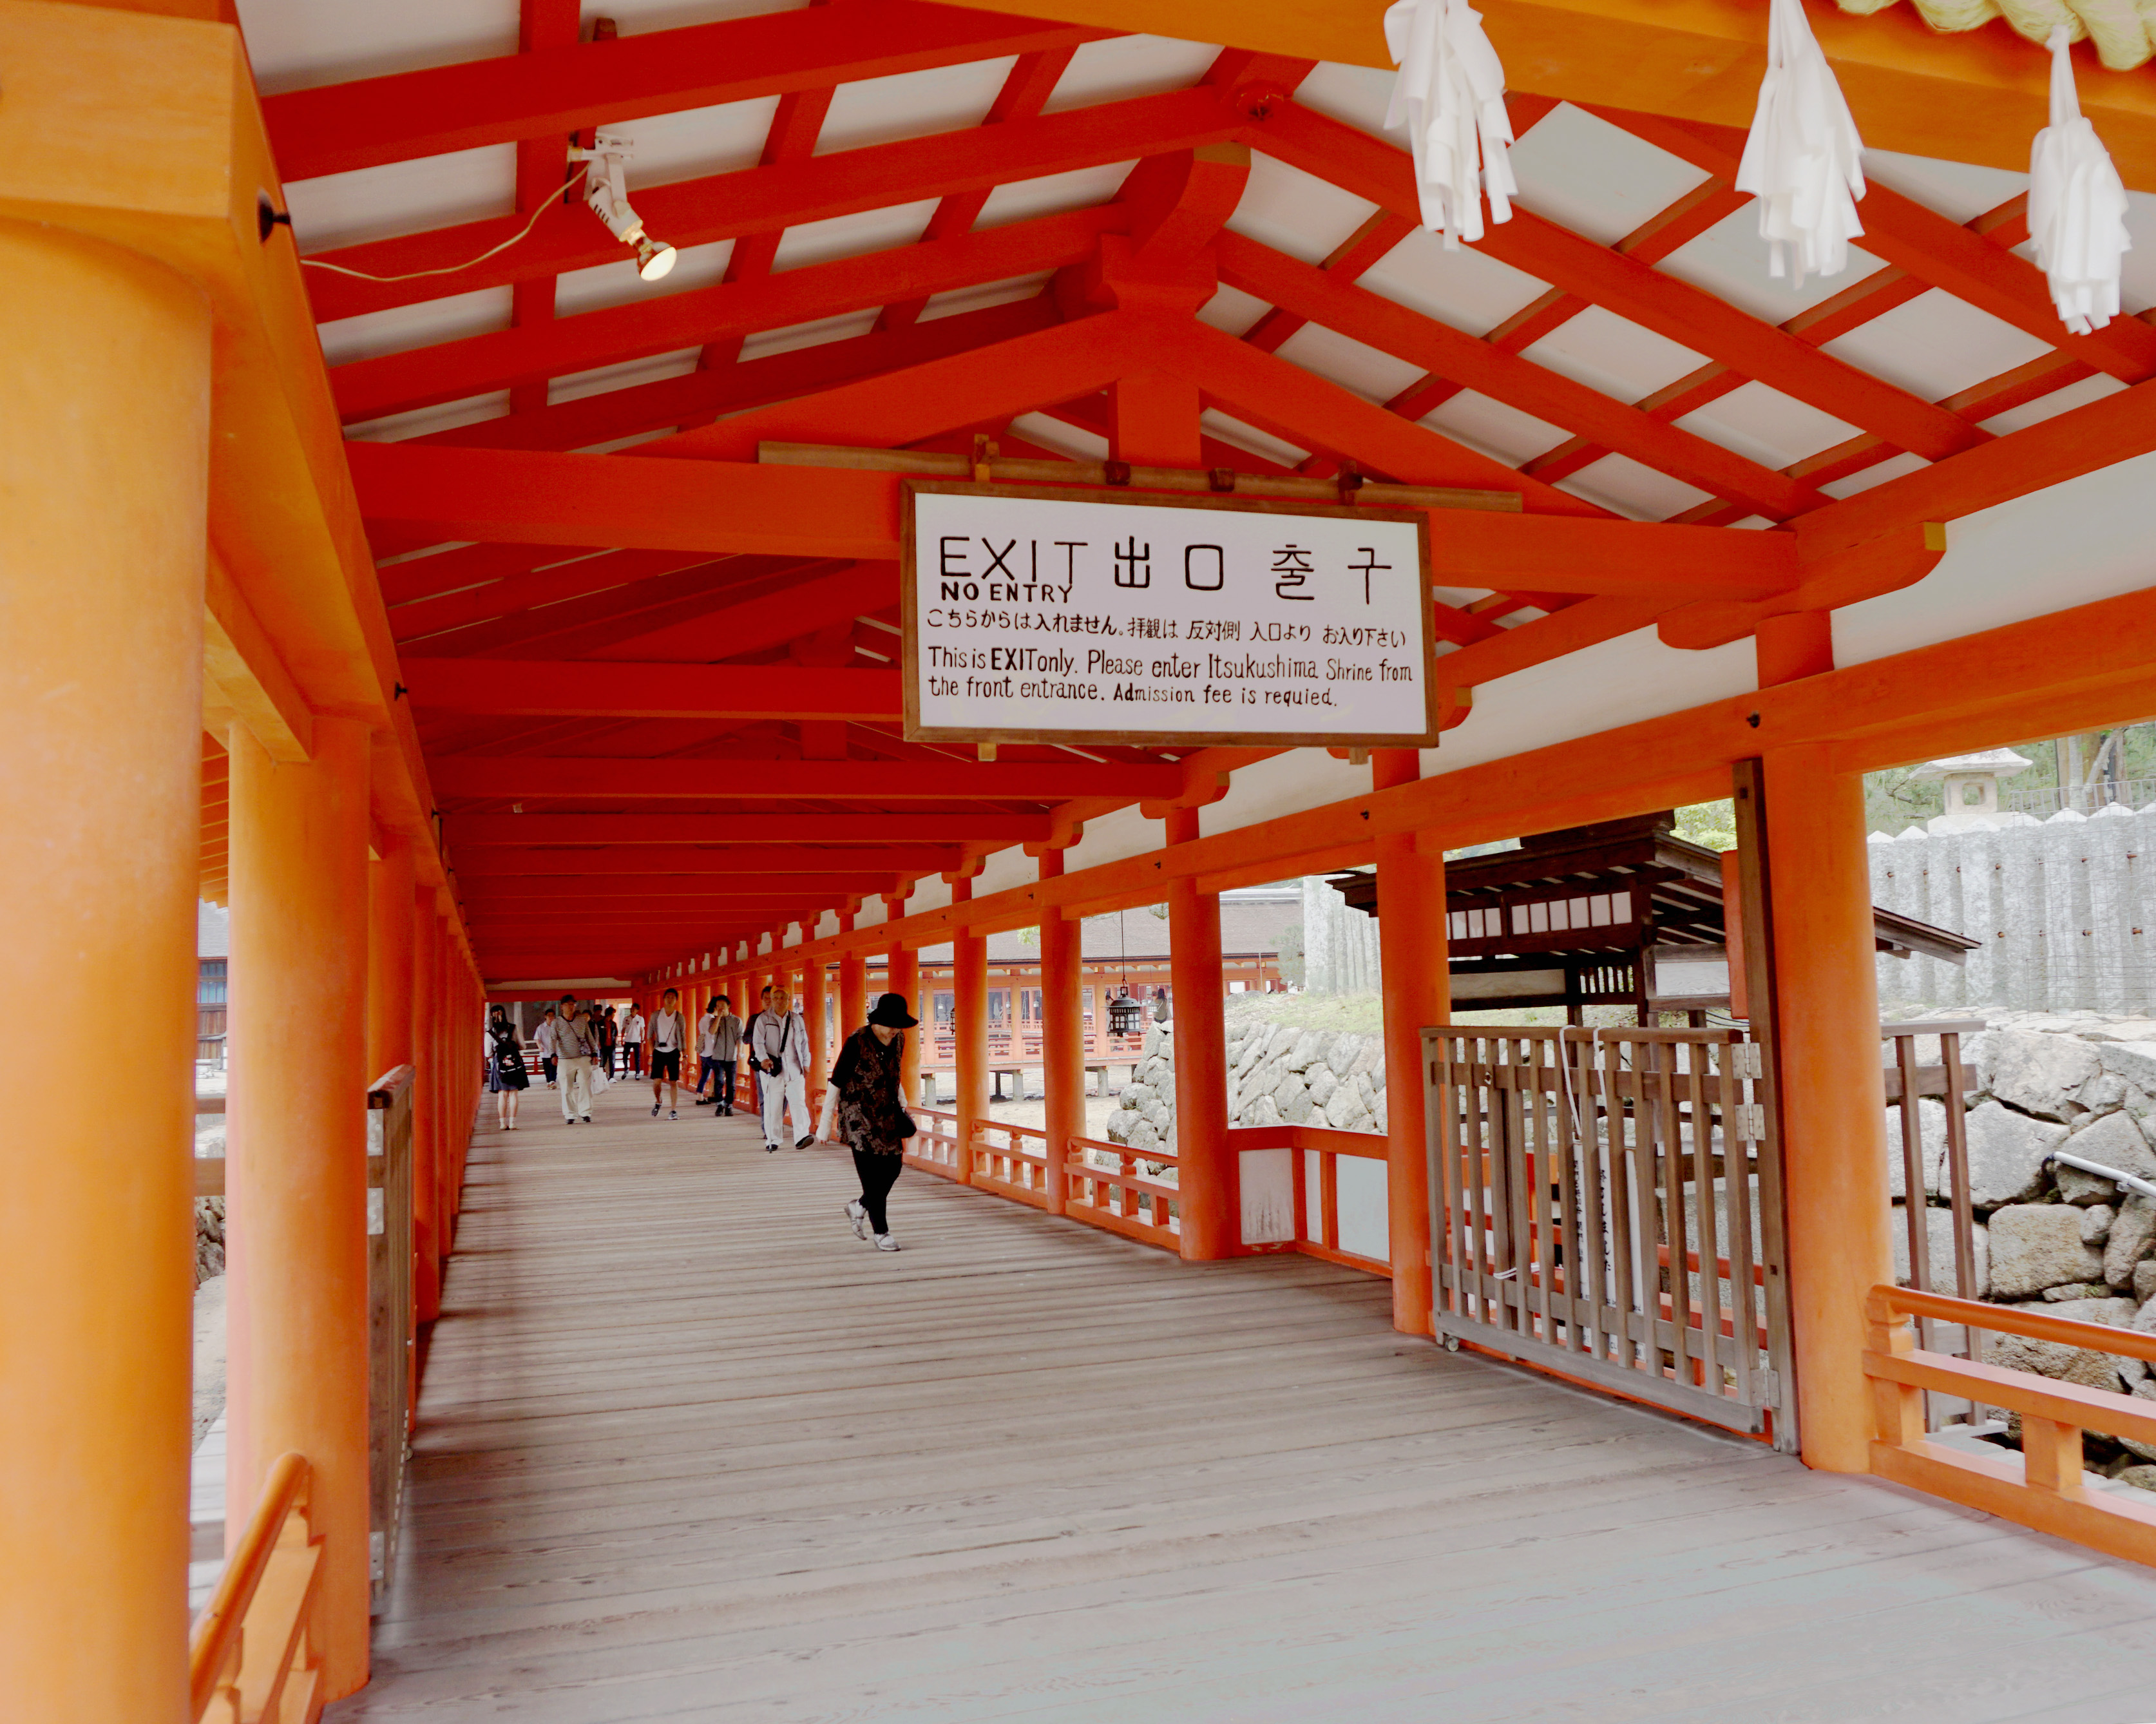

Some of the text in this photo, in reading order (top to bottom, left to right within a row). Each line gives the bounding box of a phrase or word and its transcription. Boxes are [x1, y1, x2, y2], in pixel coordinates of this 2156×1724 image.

[940, 536, 1089, 584] EXIT
[1270, 544, 1392, 605] 출구
[940, 581, 1073, 603] NO ENTRY
[928, 646, 967, 668] This
[972, 647, 986, 669] is
[1087, 649, 1143, 676] Please
[1152, 653, 1201, 678] enter
[1208, 653, 1319, 679] Itsukushima
[1326, 658, 1373, 681] Shrine
[1379, 658, 1413, 682] from
[928, 675, 1337, 707] the front entrance. Admission fee is requied.
